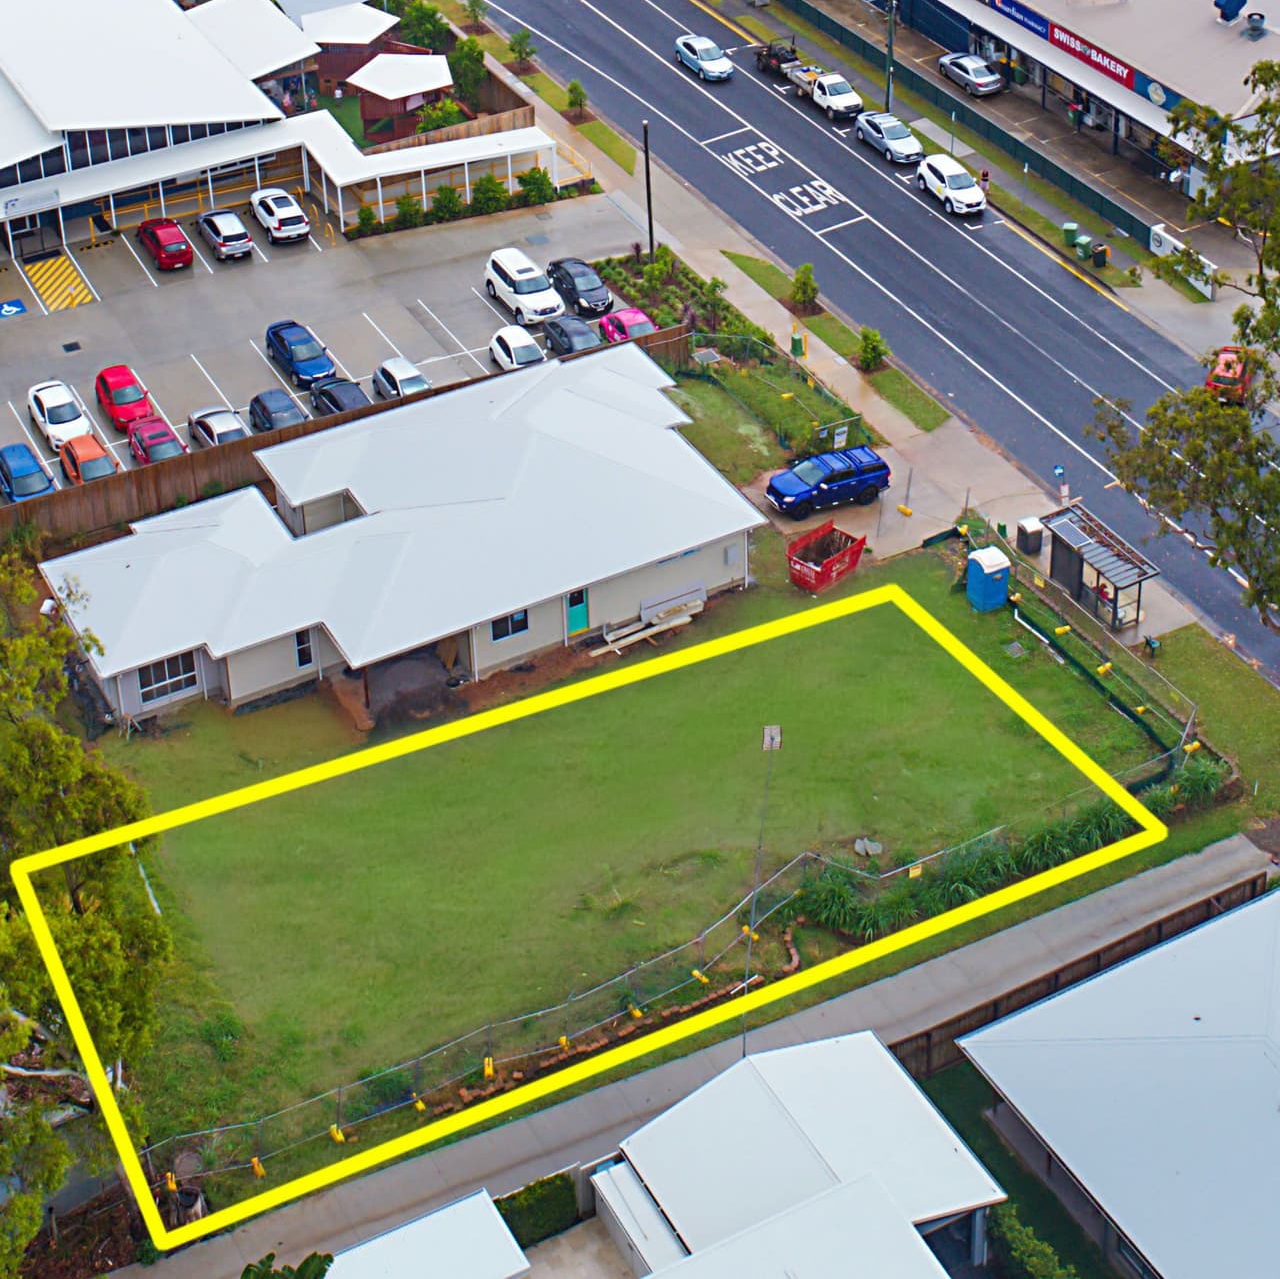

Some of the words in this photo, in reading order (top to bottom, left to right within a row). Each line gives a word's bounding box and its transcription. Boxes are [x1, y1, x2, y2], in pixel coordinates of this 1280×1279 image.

[1053, 27, 1081, 51] SWISS
[1090, 49, 1129, 79] BAKERY
[721, 141, 784, 176] KEEP
[772, 180, 847, 217] CLEAR
